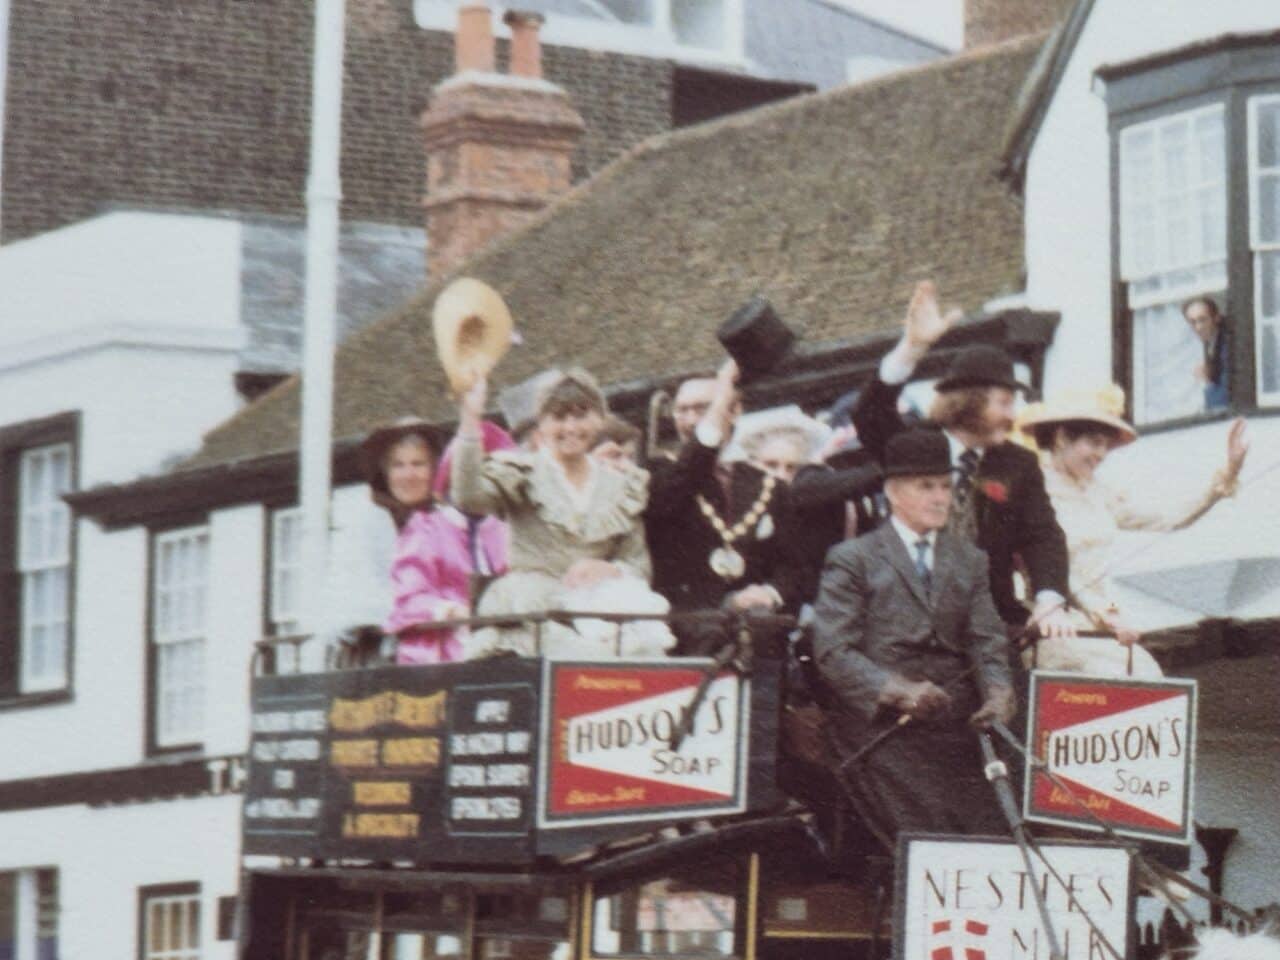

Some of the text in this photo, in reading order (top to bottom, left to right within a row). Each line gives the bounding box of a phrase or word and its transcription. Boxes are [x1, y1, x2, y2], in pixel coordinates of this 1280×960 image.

[575, 695, 728, 754] HUDSONS
[1053, 717, 1183, 768] HUDSON'S
[651, 748, 721, 776] SOAP
[1114, 768, 1171, 799] SOAP
